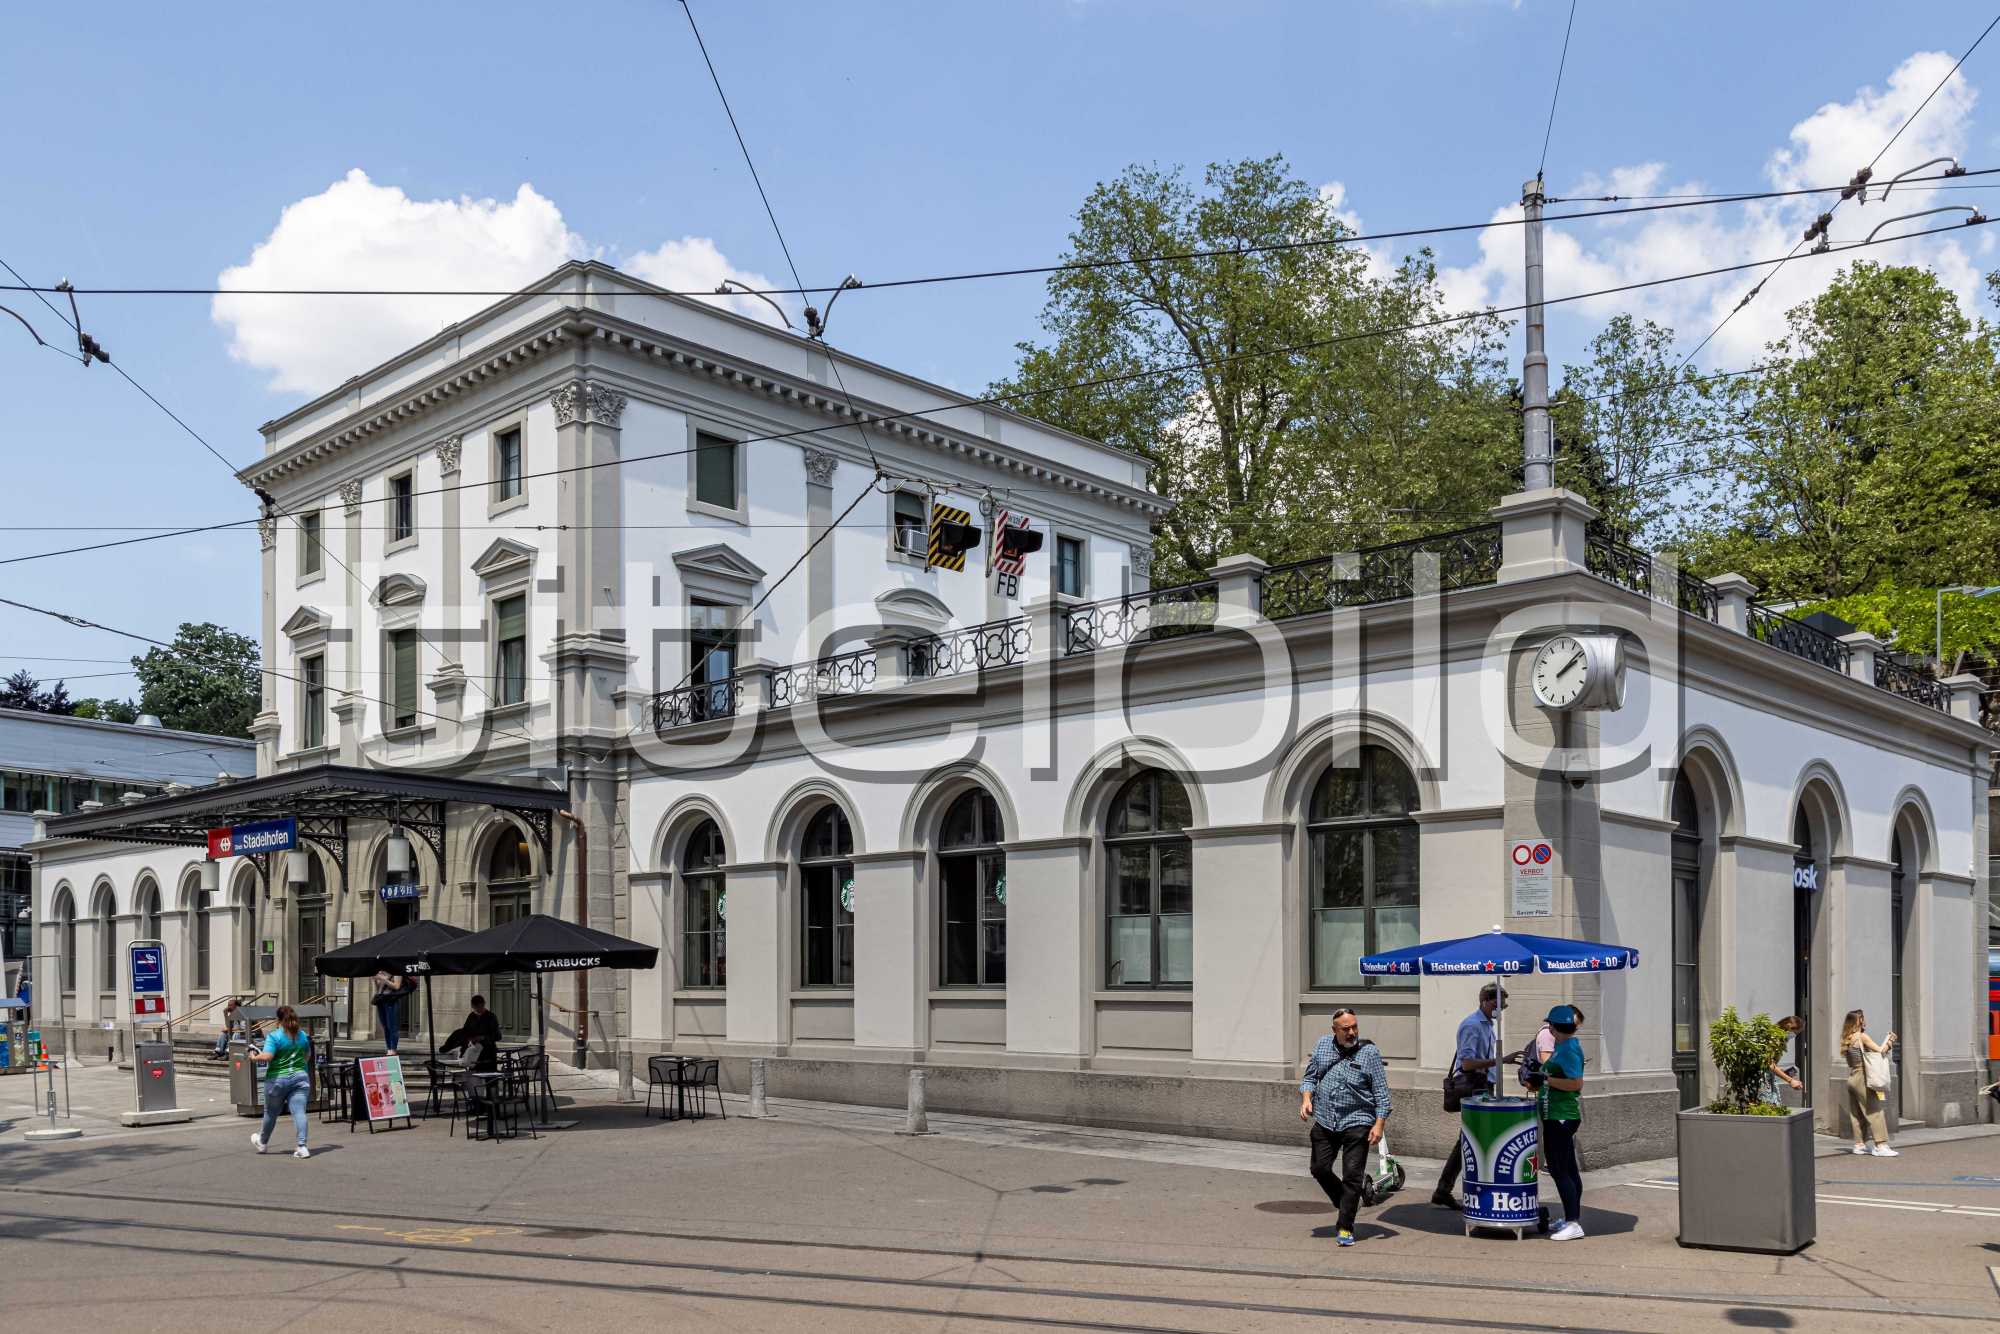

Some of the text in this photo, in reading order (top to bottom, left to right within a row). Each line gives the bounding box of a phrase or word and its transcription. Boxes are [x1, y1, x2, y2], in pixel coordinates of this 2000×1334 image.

[996, 572, 1018, 597] FB
[243, 830, 289, 849] Stadelhofen
[1792, 863, 1819, 889] osk
[535, 957, 601, 969] STARBUCKS
[1430, 960, 1519, 972] Heineken 0.0
[1462, 1141, 1475, 1172] BEER
